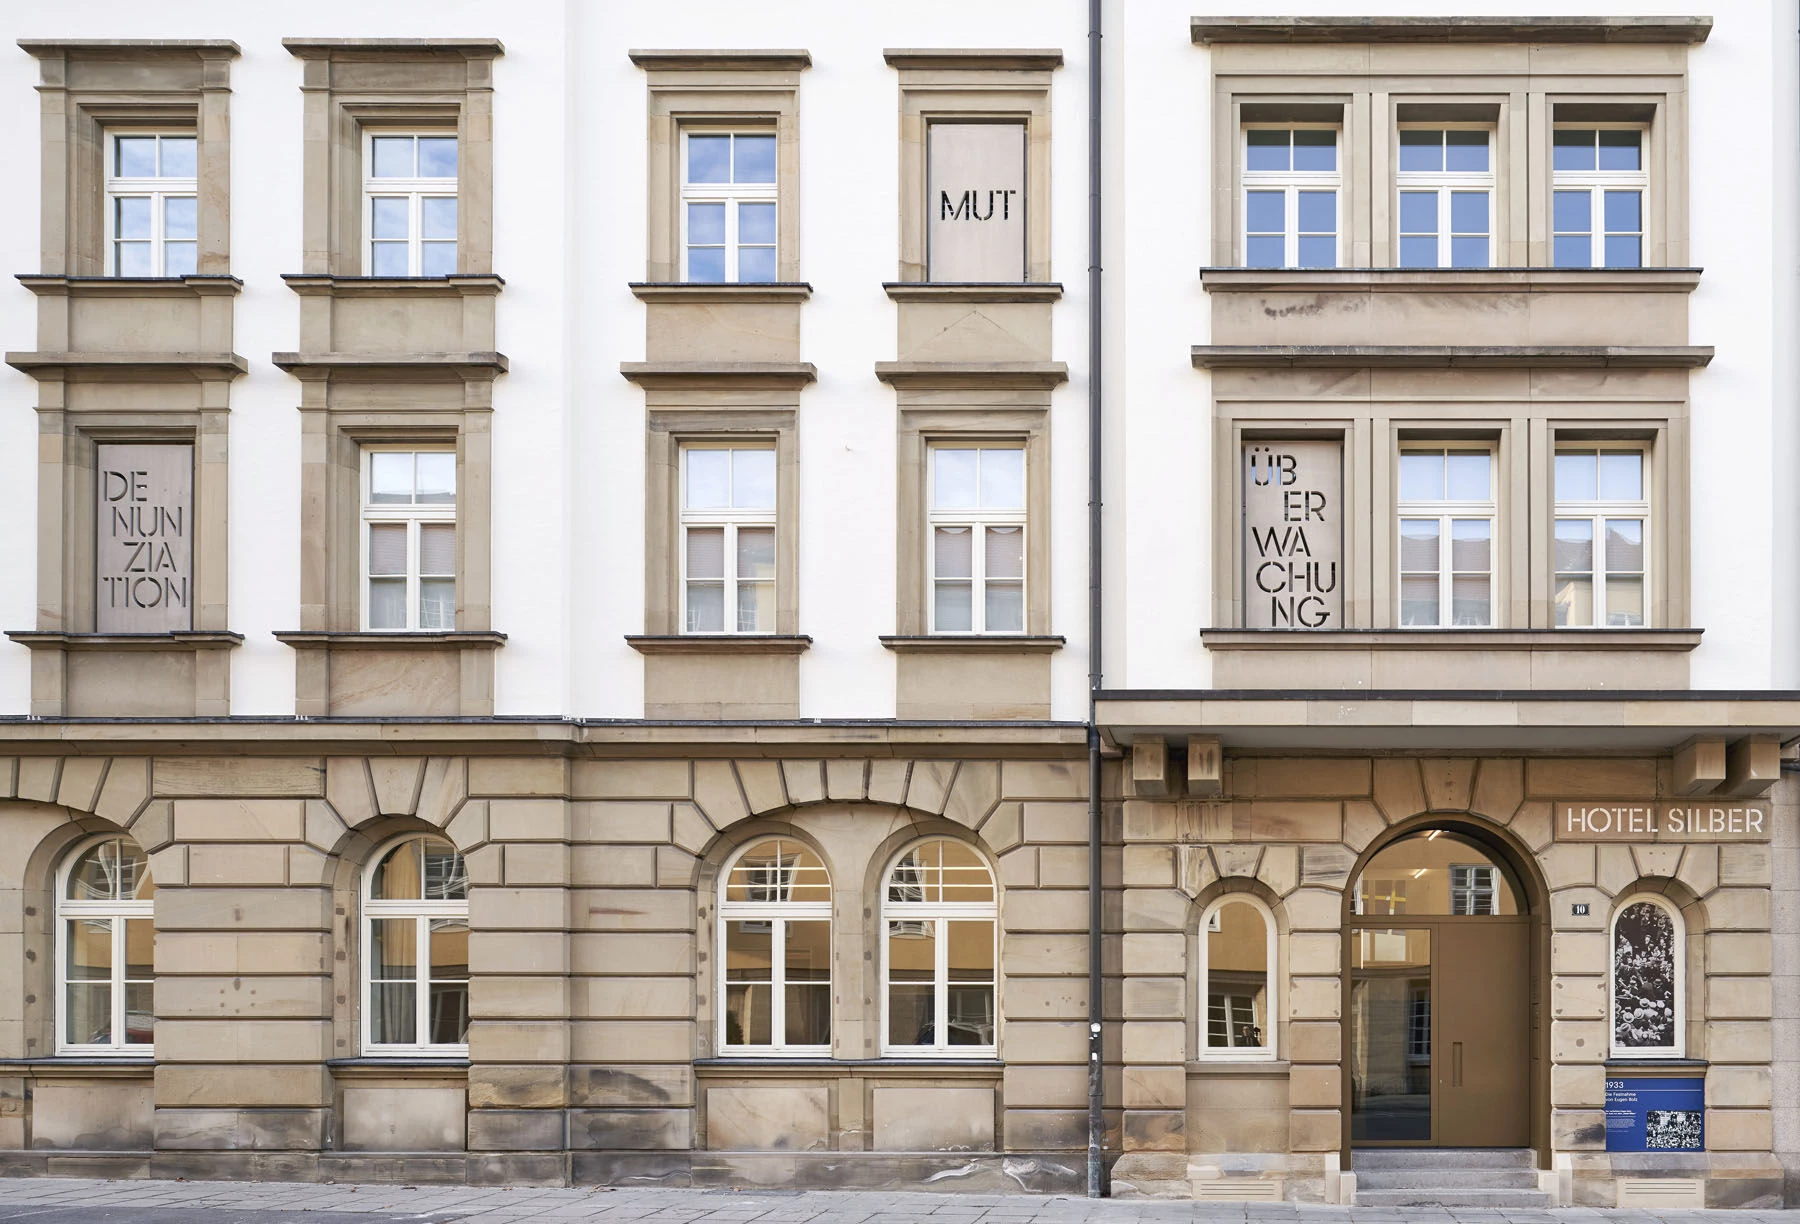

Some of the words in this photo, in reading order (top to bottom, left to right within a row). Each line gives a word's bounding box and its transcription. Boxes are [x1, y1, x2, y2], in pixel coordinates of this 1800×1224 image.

[941, 190, 1016, 221] MUT
[1251, 447, 1297, 486] ÜB
[103, 471, 148, 501] DE
[112, 506, 182, 537] NUN
[1284, 491, 1326, 522] ER
[123, 542, 177, 572] ZIA
[1251, 526, 1312, 557] WA
[103, 577, 187, 608] TION
[1255, 561, 1336, 593] CHU
[1271, 596, 1331, 627] NG
[1567, 808, 1659, 833] HOTEL
[1667, 808, 1763, 833] SILBER
[1605, 1081, 1624, 1089] 1933
